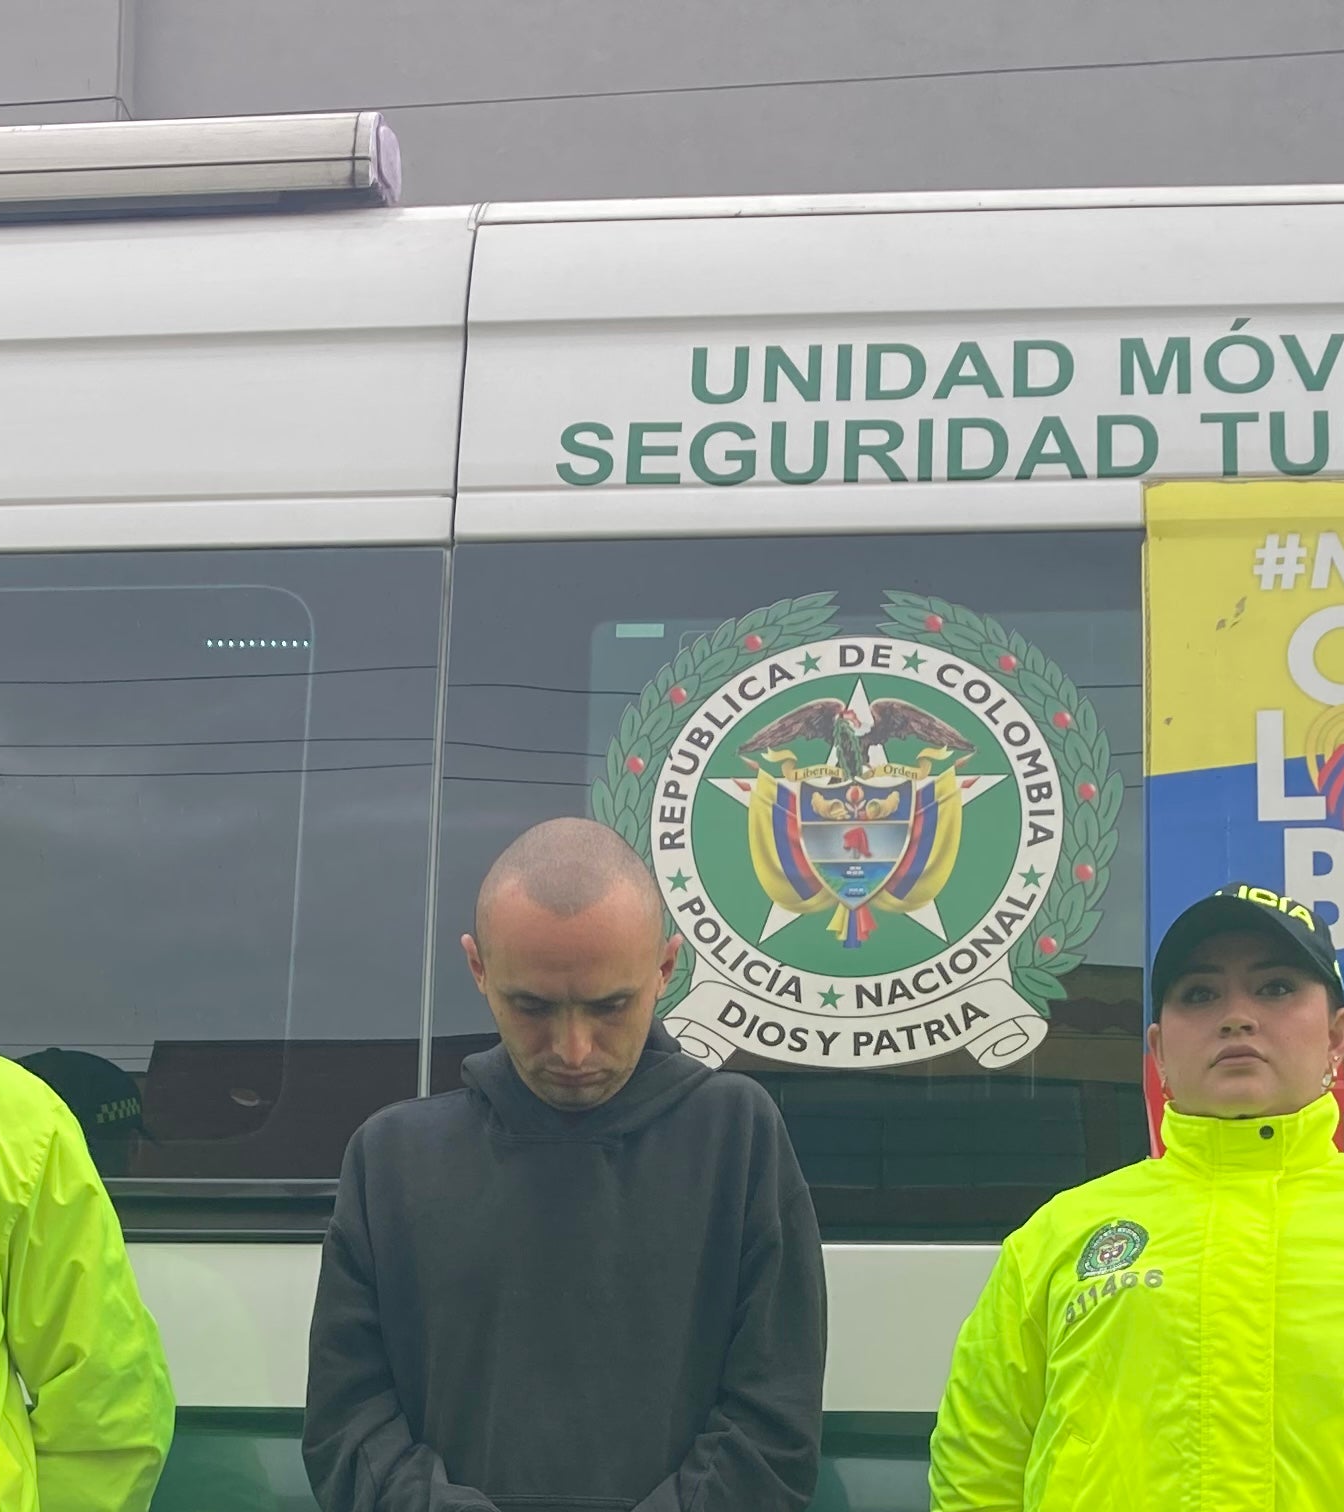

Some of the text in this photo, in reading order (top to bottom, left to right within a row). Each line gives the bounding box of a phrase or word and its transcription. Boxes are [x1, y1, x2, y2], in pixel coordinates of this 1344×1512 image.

[691, 340, 1075, 404] UNIDAD
[557, 415, 1160, 486] SEGURIDAD
[659, 644, 1056, 850] REPÚBLICA DE COLOMBIA
[794, 765, 840, 780] Libertad
[883, 764, 918, 780] Orden
[677, 892, 1037, 1009] POLICÍA NACIONAL
[717, 999, 990, 1057] DIOS Y PATRIA
